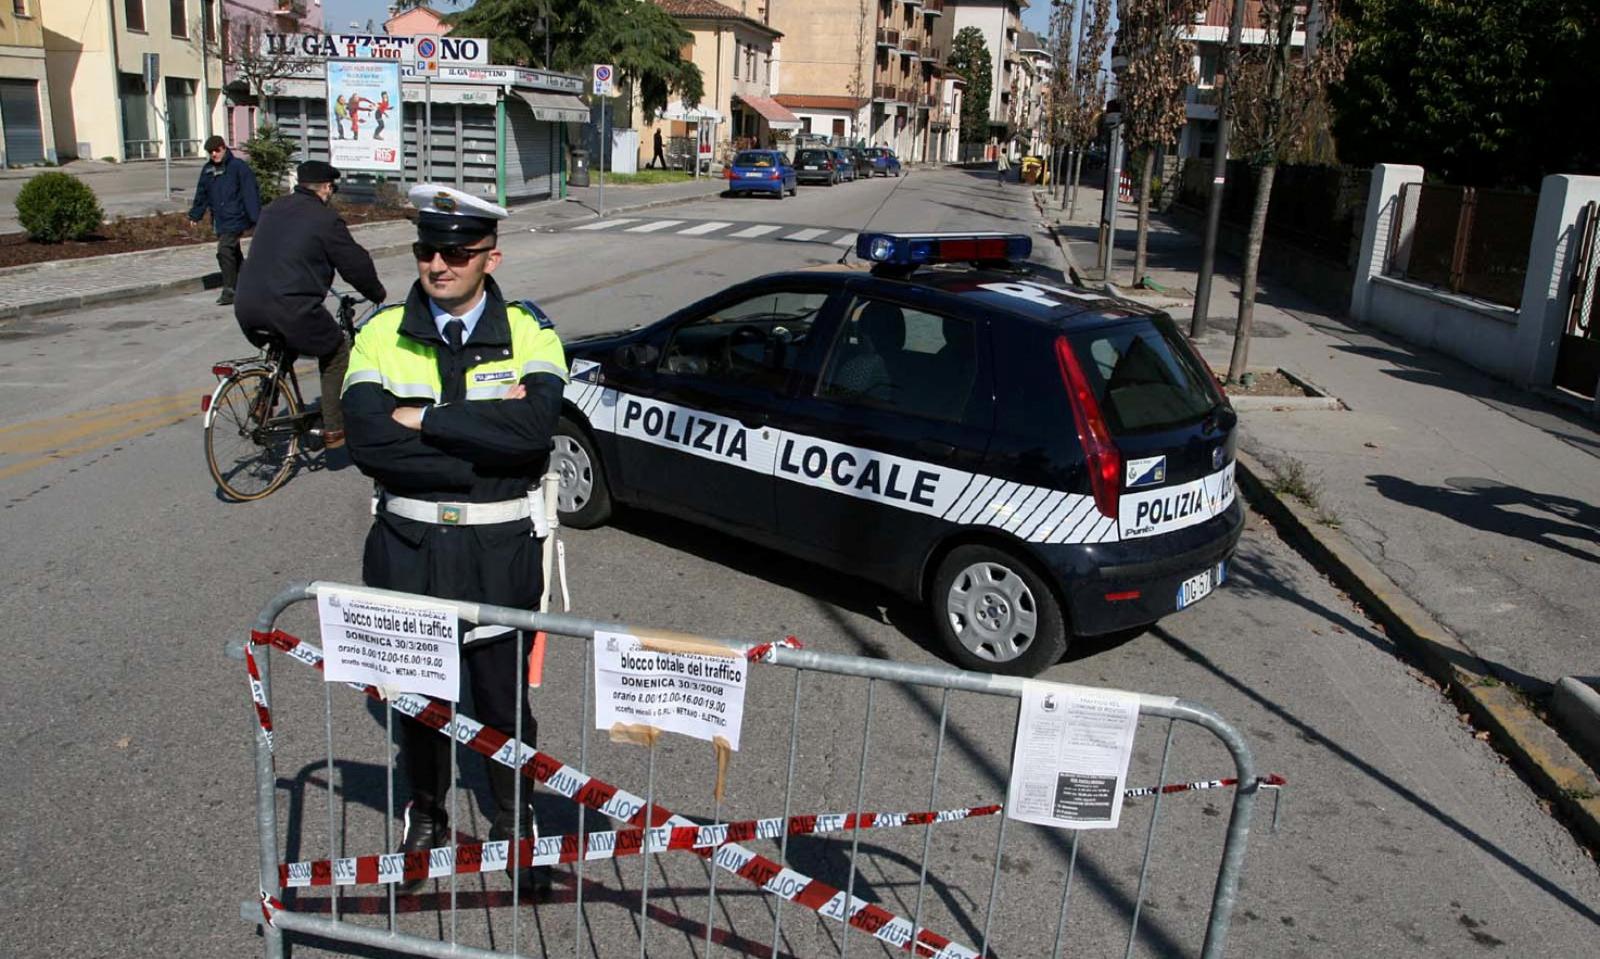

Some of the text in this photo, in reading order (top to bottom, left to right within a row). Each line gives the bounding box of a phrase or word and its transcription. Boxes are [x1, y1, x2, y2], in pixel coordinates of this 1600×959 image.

[302, 34, 479, 61] GAZZETNO
[623, 399, 941, 507] POLIZIA LOCALE
[1136, 489, 1203, 527] POLIZIA
[1125, 526, 1155, 537] Punto
[342, 608, 371, 627] blocco
[374, 614, 400, 632] totale
[402, 616, 417, 634] del
[419, 619, 453, 639] traffico
[338, 644, 360, 655] orario
[345, 630, 392, 648] DOMENICA
[621, 652, 742, 683] blocco totale del traffico
[621, 676, 675, 689] DOMENICA
[613, 691, 636, 702] orario
